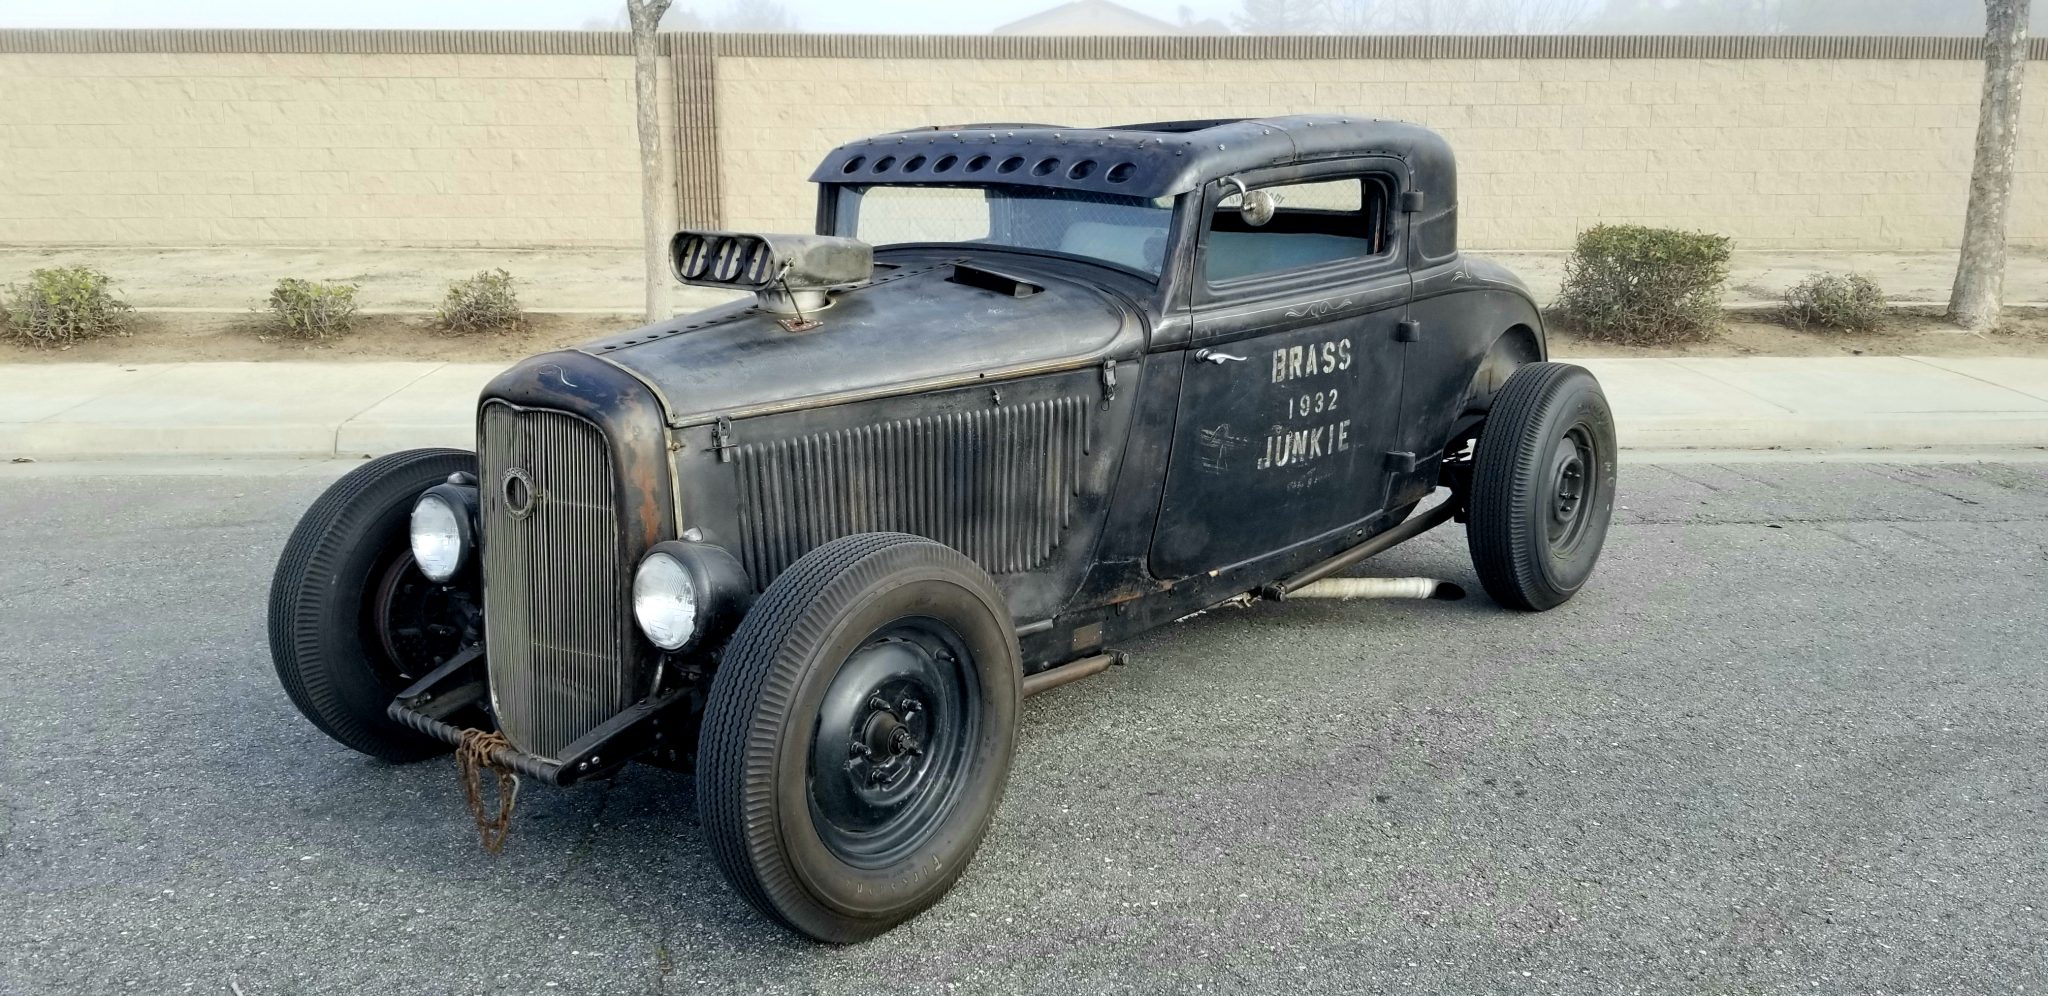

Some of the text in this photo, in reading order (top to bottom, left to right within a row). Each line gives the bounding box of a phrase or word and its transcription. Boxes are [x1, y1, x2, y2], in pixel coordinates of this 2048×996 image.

[1272, 338, 1350, 383] BRASS
[1289, 389, 1338, 419] 1932
[1257, 419, 1350, 469] JUNKIE
